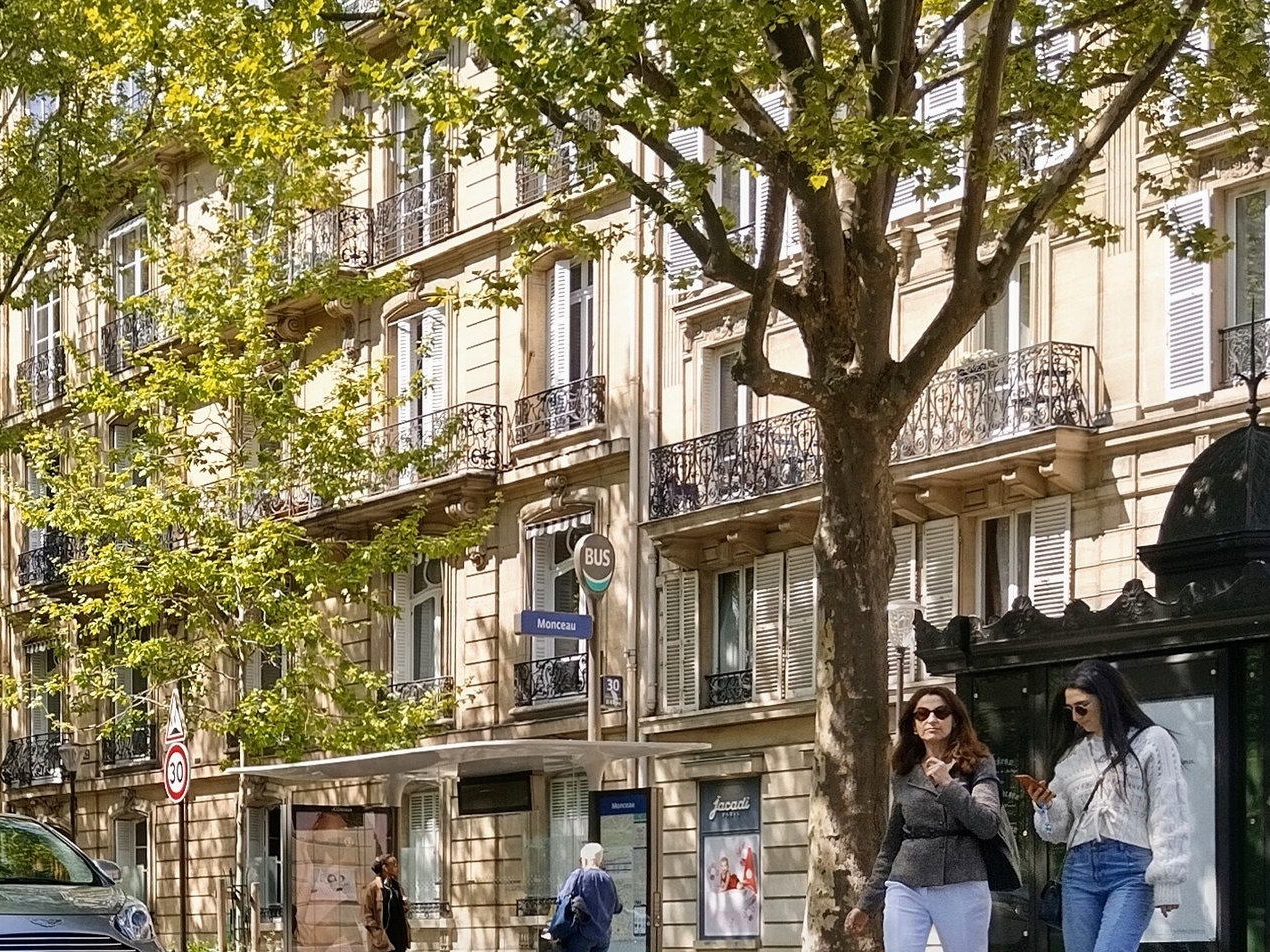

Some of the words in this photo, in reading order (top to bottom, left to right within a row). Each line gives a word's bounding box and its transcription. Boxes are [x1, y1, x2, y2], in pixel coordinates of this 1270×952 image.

[585, 547, 610, 567] BUS
[537, 618, 576, 631] Monceau
[606, 678, 620, 691] 30
[170, 761, 184, 784] 30
